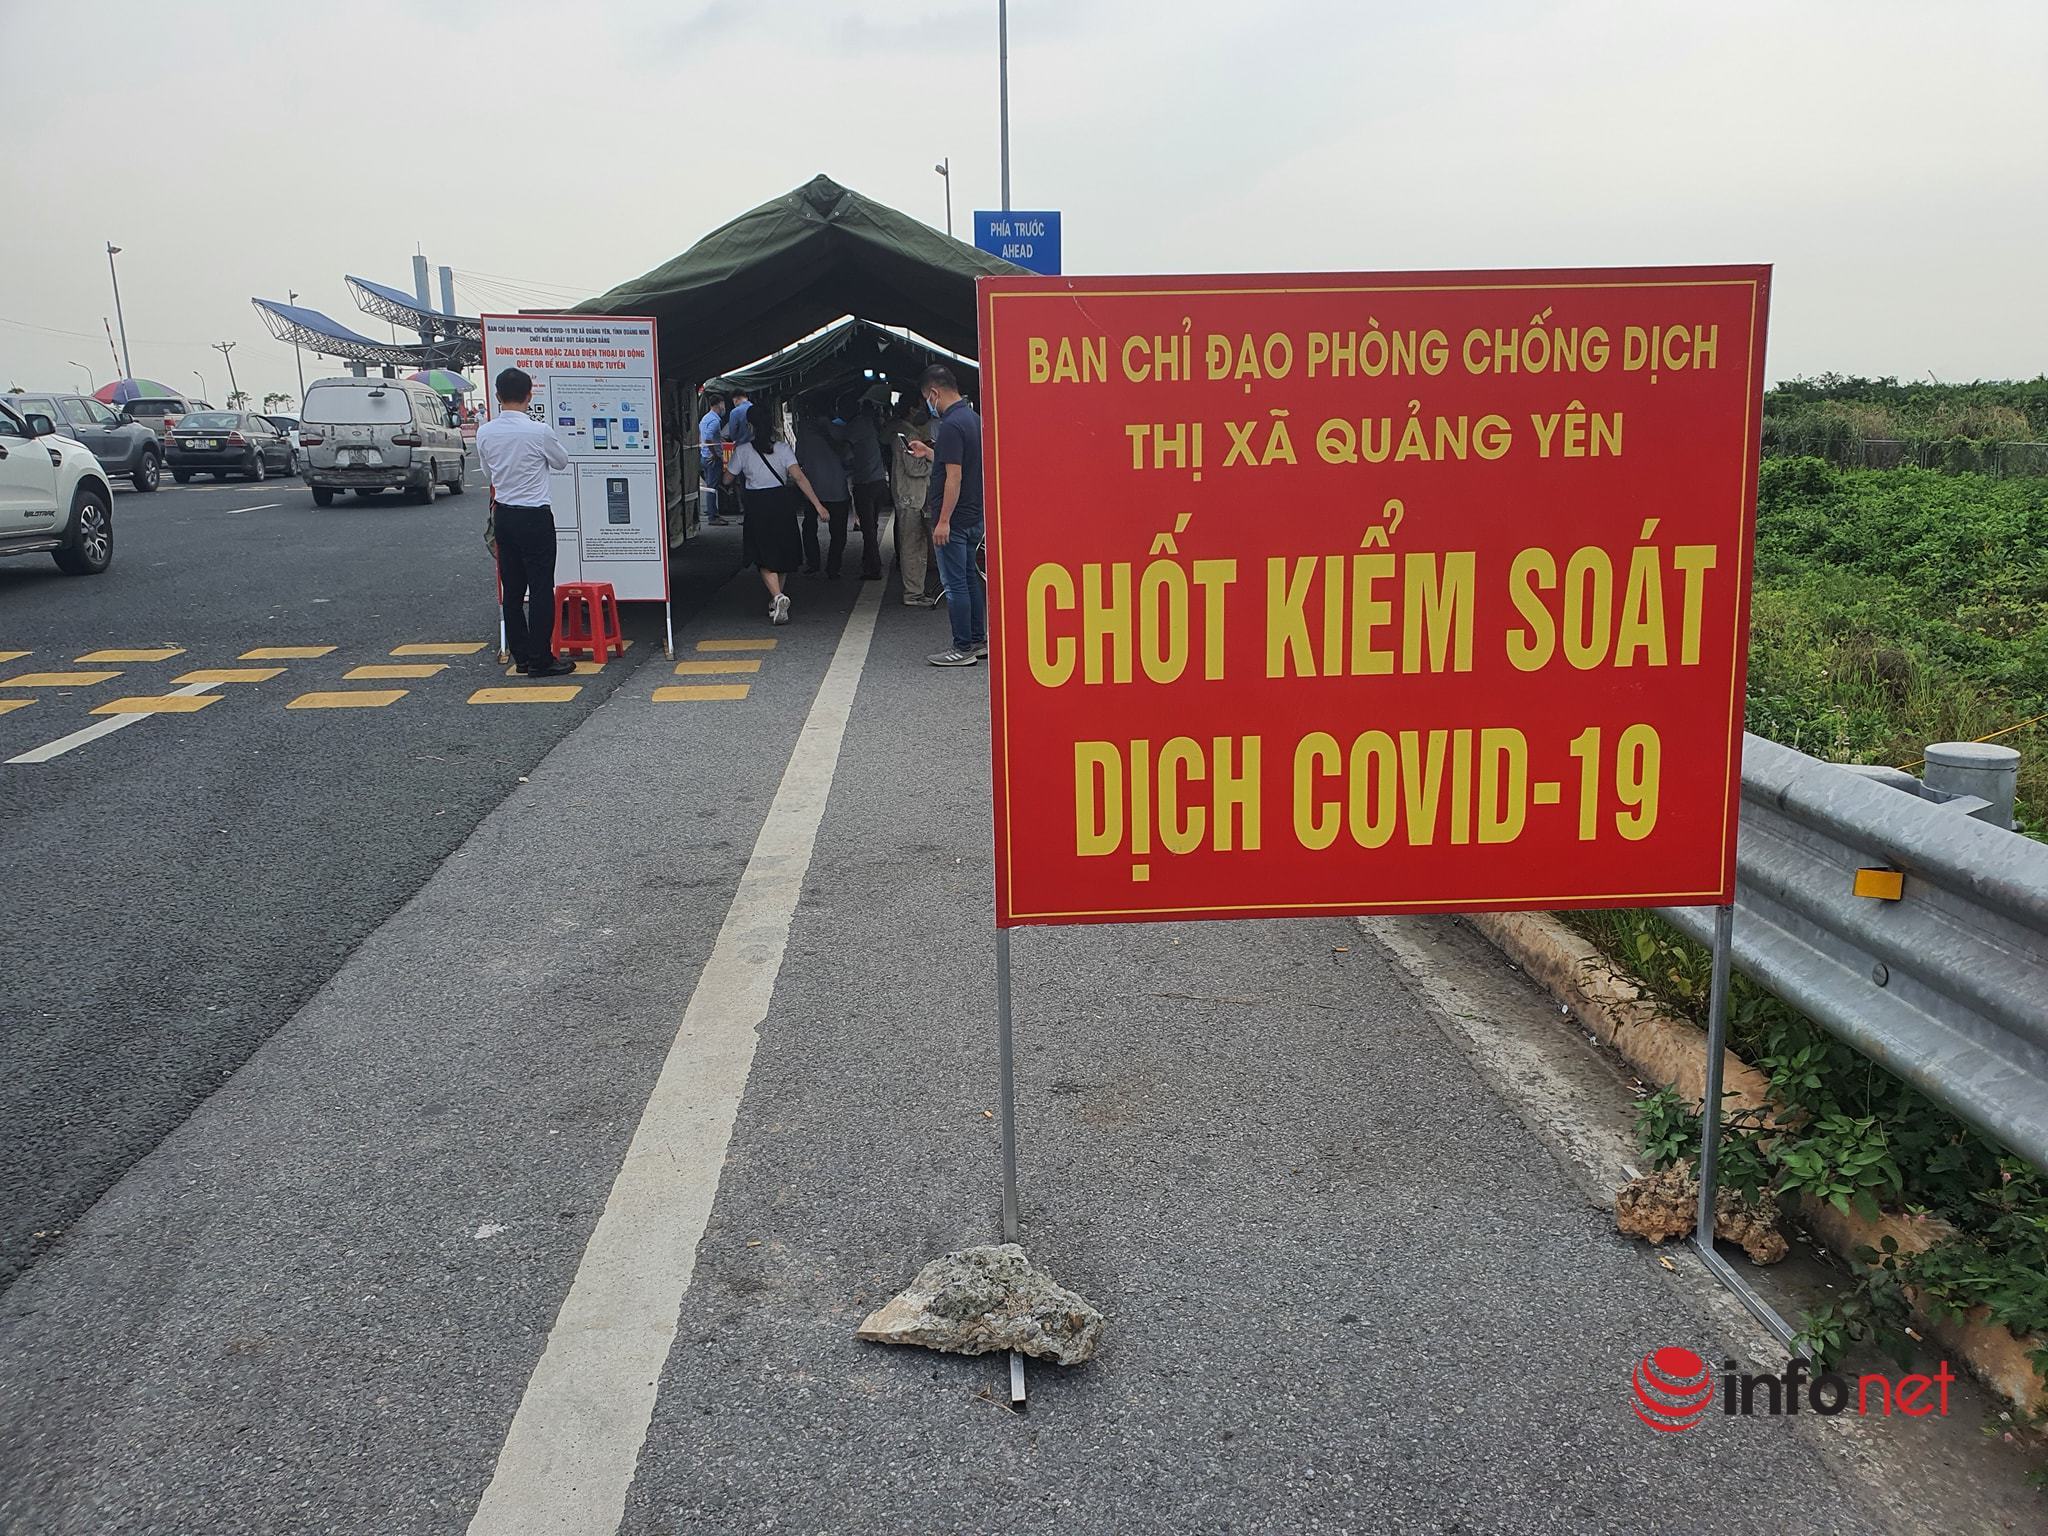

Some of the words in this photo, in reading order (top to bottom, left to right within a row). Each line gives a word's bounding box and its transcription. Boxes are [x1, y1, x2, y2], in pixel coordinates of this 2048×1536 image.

[990, 219, 1011, 236] PHÍA
[1014, 219, 1045, 236] TRƯỚC
[1002, 244, 1033, 258] AHEAD
[495, 345, 514, 355] DÙNG
[515, 347, 543, 356] CAMERA
[545, 347, 563, 358] HOẶC
[564, 348, 580, 357] ZALO
[599, 349, 618, 359] THOẠI
[619, 350, 626, 358] DI
[517, 359, 533, 368] QUÉT
[556, 361, 571, 369] KHAI
[573, 360, 586, 369] BÁO
[587, 361, 604, 370] TRỰC
[606, 359, 626, 370] TUYẾN
[1029, 336, 1107, 384] BAN
[1122, 316, 1192, 382] CHỈ
[1206, 332, 1293, 394] ĐẠO
[1308, 317, 1449, 378] PHÒNG
[1463, 306, 1610, 375] CHỐNG
[1624, 325, 1718, 384] DỊCH
[1126, 423, 1203, 482] THỊ
[1223, 409, 1298, 468] XÃ
[1316, 400, 1512, 464] QUẢNG
[1531, 400, 1623, 458] YÊN
[1026, 512, 1237, 687] CHỐT
[1266, 498, 1476, 679] KIỂM
[1506, 518, 1718, 672] SOÁT
[1074, 735, 1262, 882] DỊCH
[1293, 723, 1661, 851] COVID-19
